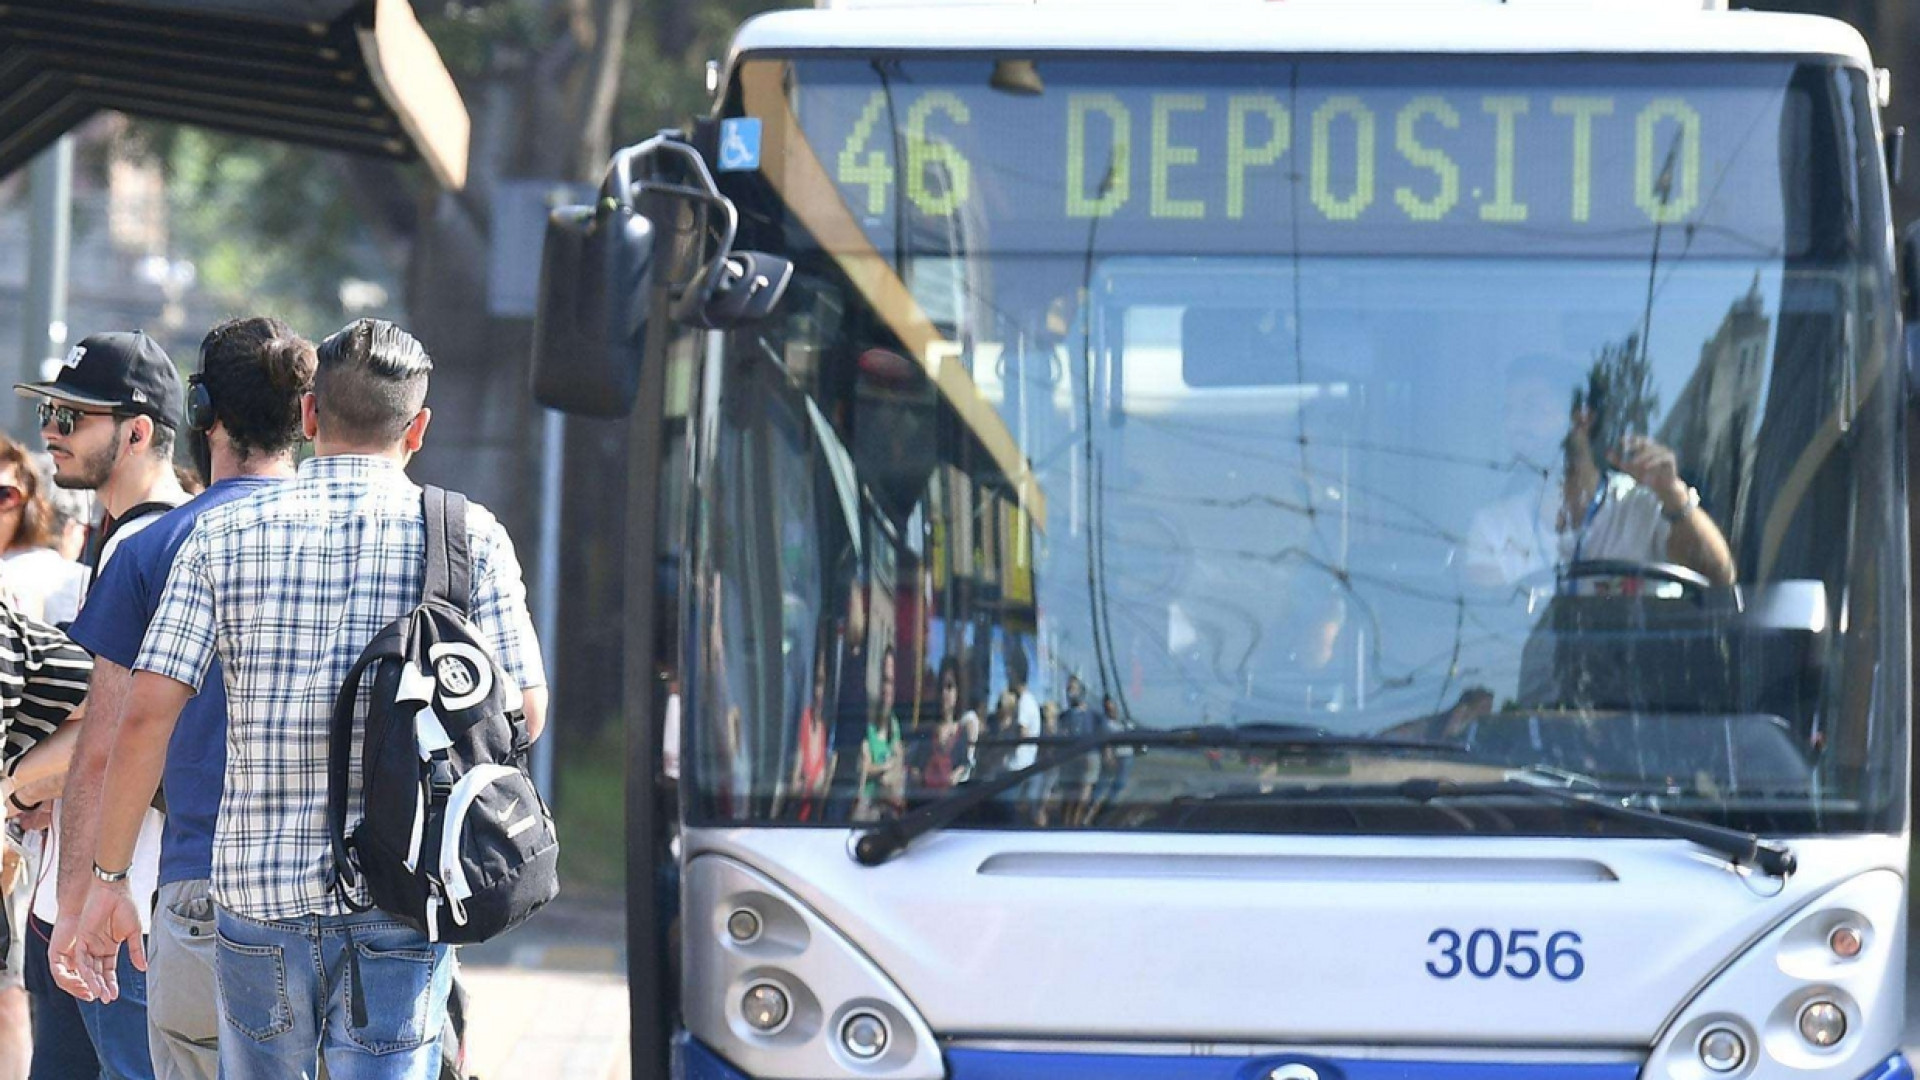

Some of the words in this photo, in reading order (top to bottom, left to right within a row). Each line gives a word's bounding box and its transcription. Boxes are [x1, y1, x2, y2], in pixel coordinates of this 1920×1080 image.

[838, 91, 970, 215] 46
[1066, 93, 1699, 223] DEPOSITO
[1425, 928, 1585, 981] 3056
